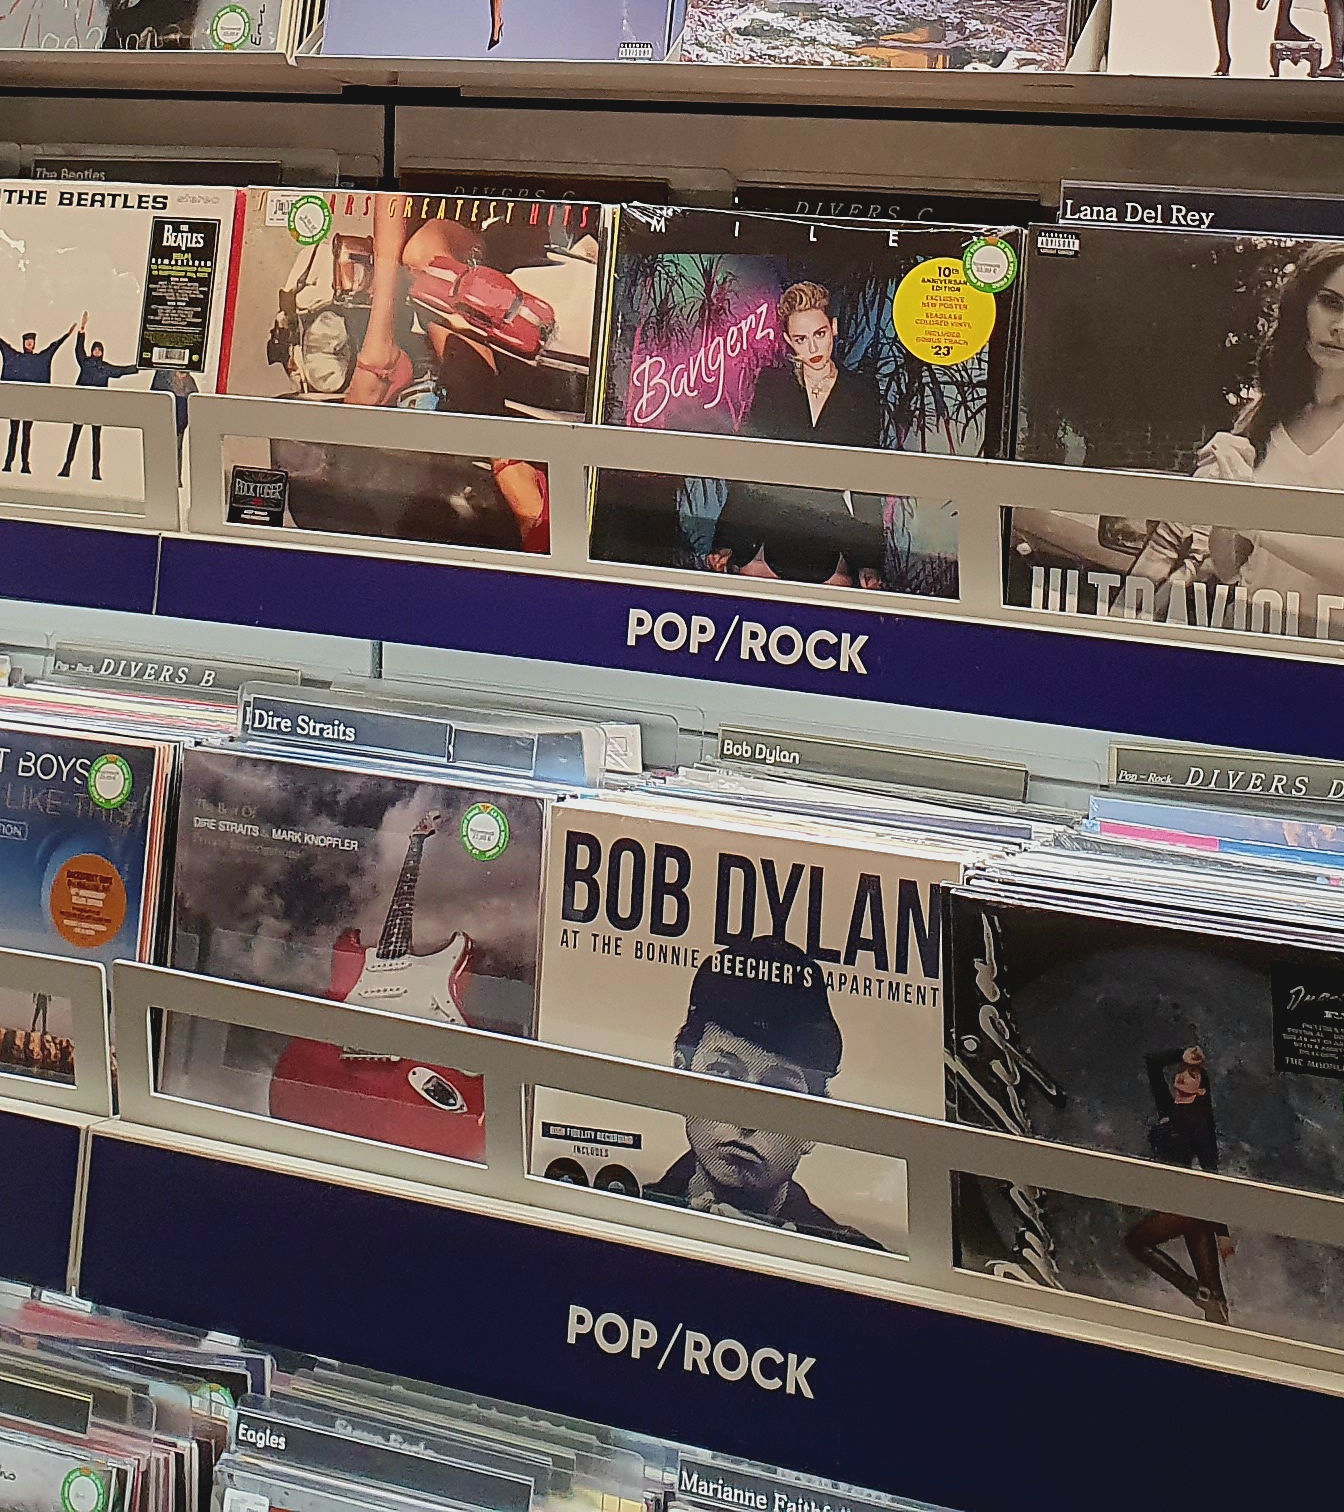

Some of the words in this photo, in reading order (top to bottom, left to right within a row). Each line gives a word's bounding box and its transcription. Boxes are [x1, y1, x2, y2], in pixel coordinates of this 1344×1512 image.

[60, 168, 106, 181] Beatles
[3, 189, 47, 206] THE
[57, 191, 169, 211] BEATLES
[387, 195, 515, 225] GREATEST
[528, 202, 590, 229] HITS
[1064, 199, 1118, 222] Lana
[1125, 203, 1164, 225] Del
[1170, 206, 1215, 230] Rey
[162, 224, 204, 250] BEATLES
[633, 302, 775, 425] Bangerz
[627, 607, 870, 675] POP/ROCK
[99, 657, 188, 685] DIVERS
[200, 669, 218, 687] B
[253, 710, 293, 734] Dire
[297, 714, 356, 743] Straits
[17, 751, 92, 786] BOYS
[722, 738, 752, 760] Bob
[755, 742, 800, 766] Dylan
[1119, 768, 1144, 784] Pop
[1149, 772, 1173, 785] Rock
[1186, 766, 1309, 797] DIVERS
[5, 783, 65, 817] LIKE
[193, 816, 217, 830] DIRE
[218, 820, 260, 837] STRAITS
[271, 827, 302, 844] MARK
[304, 832, 359, 852] KNOPFLER
[561, 829, 693, 940] BOB
[712, 851, 943, 981] DYLAN
[560, 928, 581, 950] AT
[591, 932, 623, 957] THE
[634, 941, 701, 970] BONNIE
[711, 953, 814, 988] BEECHER'S
[825, 970, 941, 1009] APARTMENT
[567, 1304, 817, 1399] POP/ROCK
[238, 1422, 287, 1451] Eagles
[680, 1469, 768, 1510] Marianne
